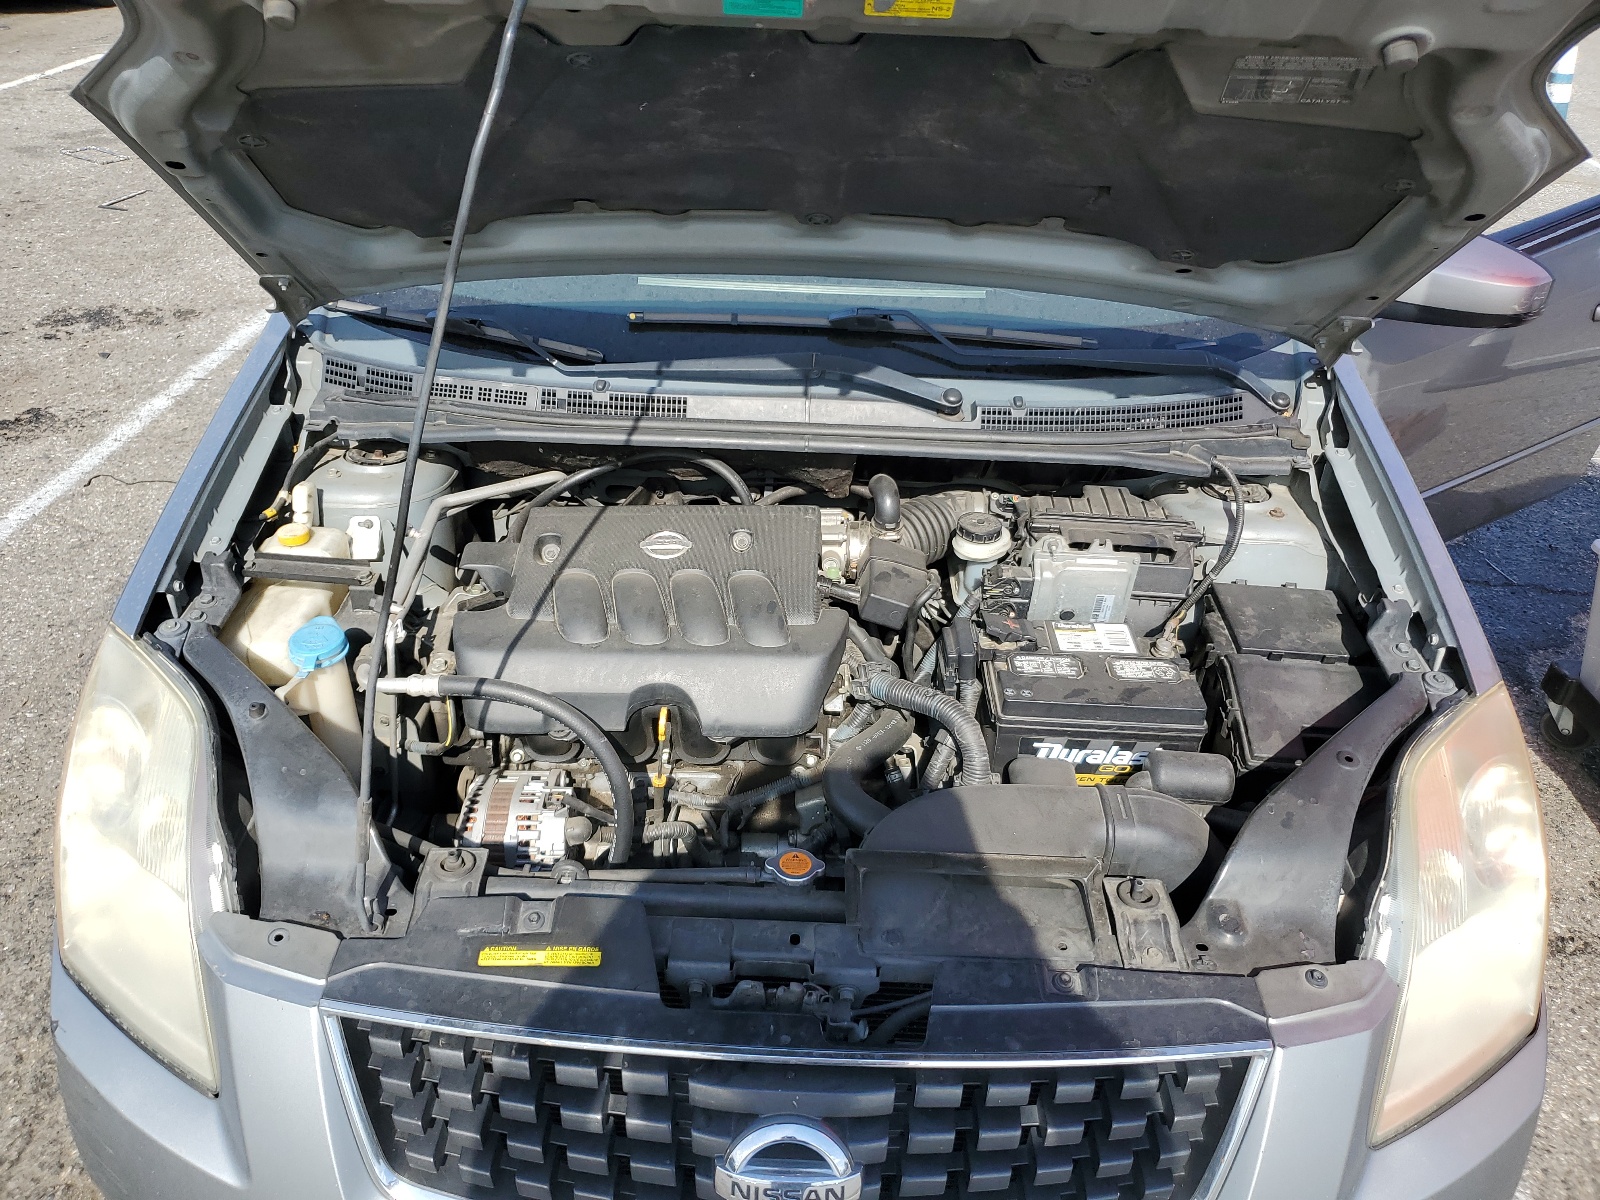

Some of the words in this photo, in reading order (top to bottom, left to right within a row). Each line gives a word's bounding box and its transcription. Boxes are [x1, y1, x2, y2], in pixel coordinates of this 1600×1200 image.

[1032, 741, 1151, 765] Duralas
[1098, 764, 1132, 773] GO
[730, 1180, 846, 1200] NISSAN
